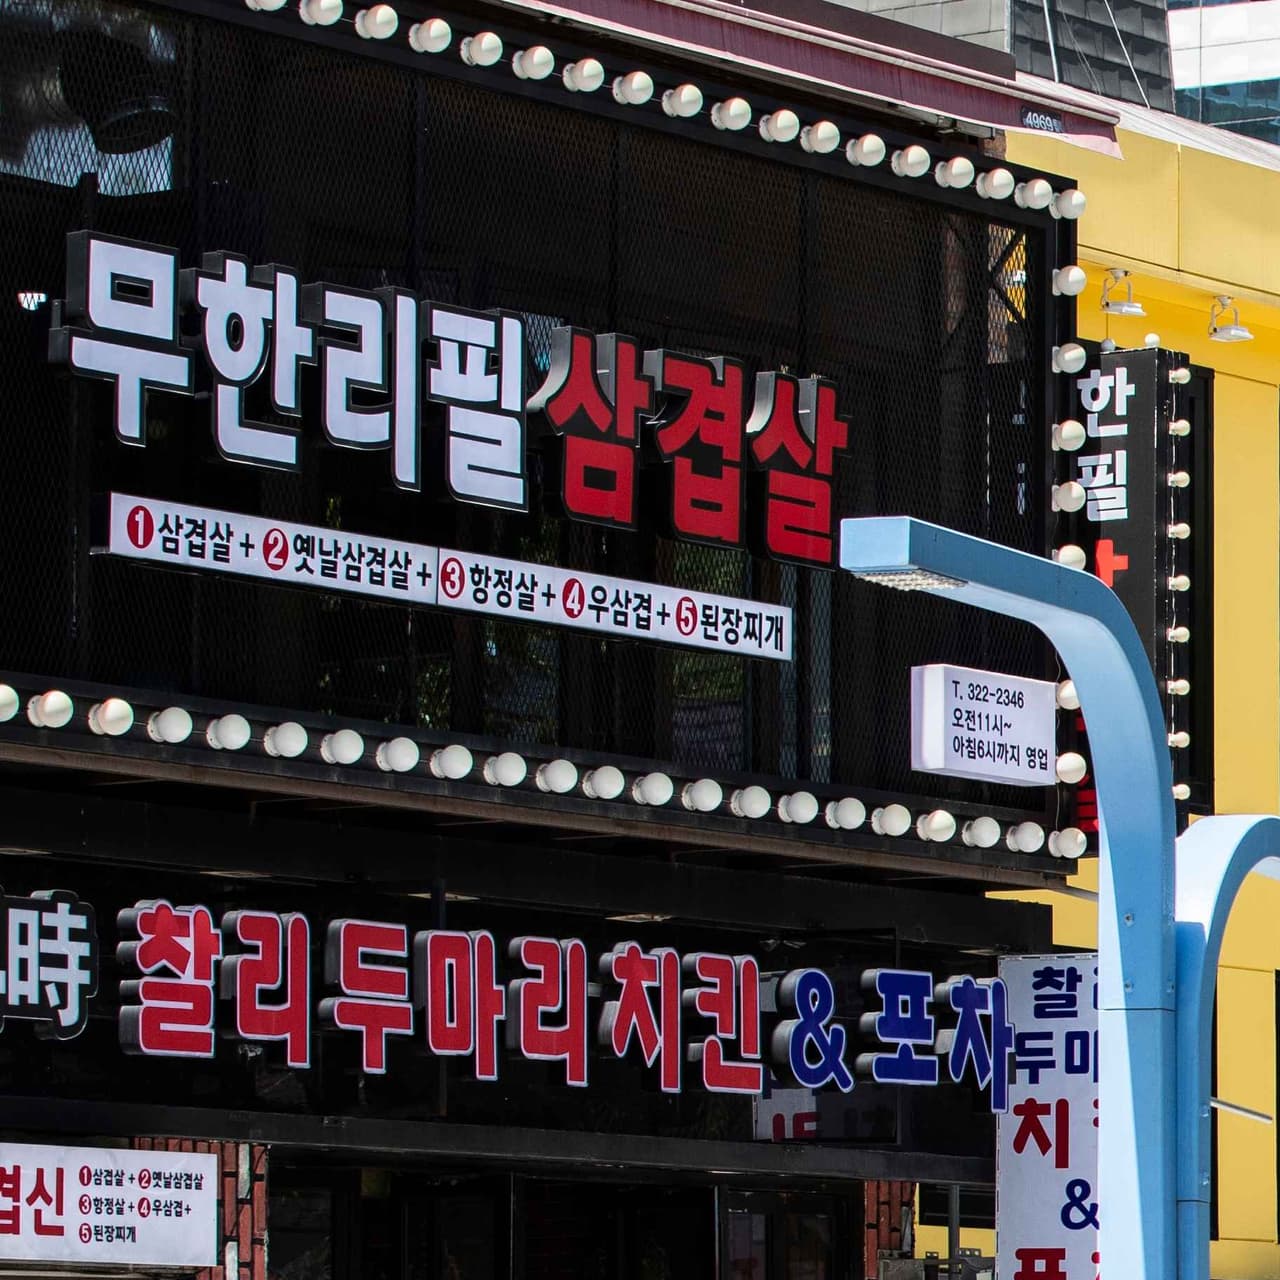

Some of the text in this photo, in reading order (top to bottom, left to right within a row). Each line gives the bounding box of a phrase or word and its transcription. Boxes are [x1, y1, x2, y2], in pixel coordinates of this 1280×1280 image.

[71, 238, 850, 564] 무한리필 삼겹살
[699, 604, 786, 654] 된장찌개
[967, 683, 1025, 709] 322-2346
[952, 735, 1049, 771] 아침6시까지 영업
[0, 901, 92, 1028] 時
[611, 939, 764, 1095] 치킨
[789, 968, 855, 1093] &
[872, 967, 1016, 1114] 포차
